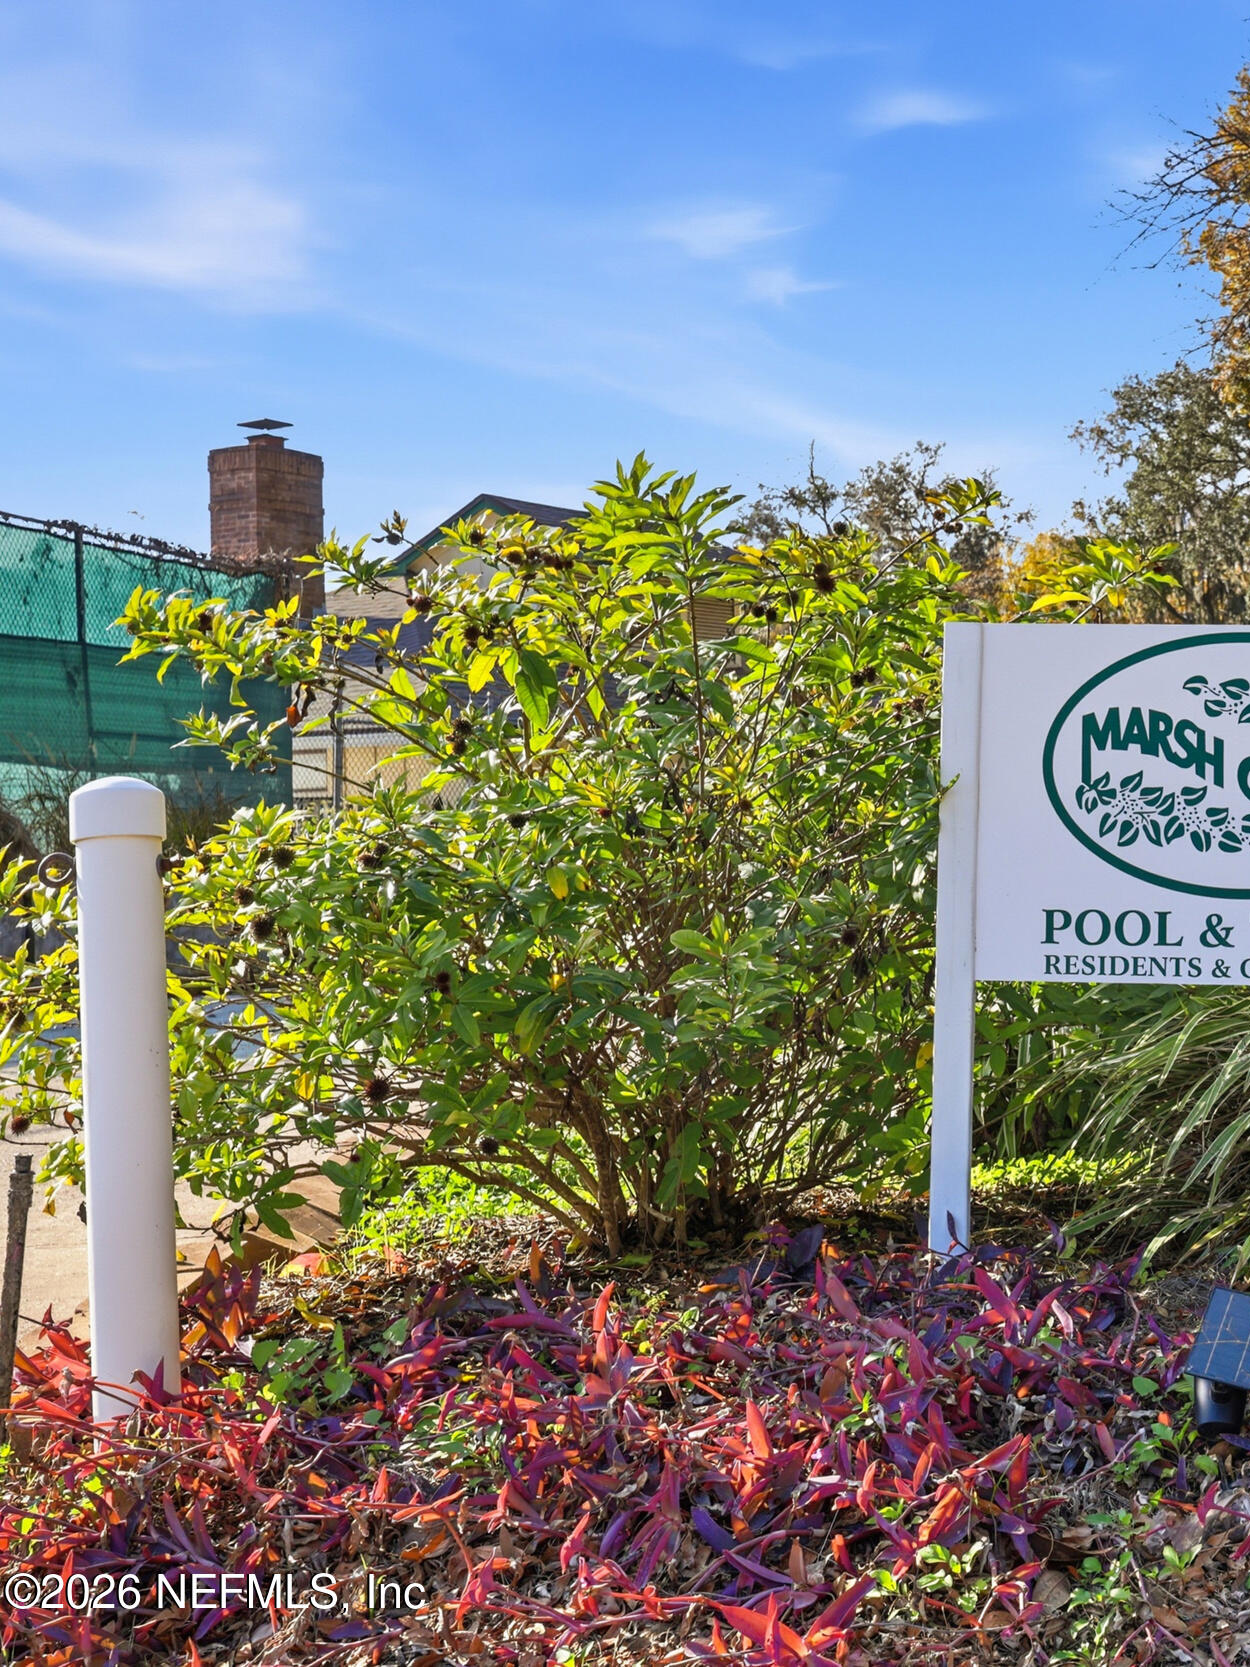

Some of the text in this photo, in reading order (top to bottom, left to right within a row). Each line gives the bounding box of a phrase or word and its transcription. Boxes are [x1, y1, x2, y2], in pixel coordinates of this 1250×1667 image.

[1081, 706, 1225, 788] MARSH
[1040, 908, 1184, 948] POOL
[1199, 912, 1234, 948] &
[1043, 954, 1202, 979] RESIDENTS
[1211, 957, 1231, 979] &
